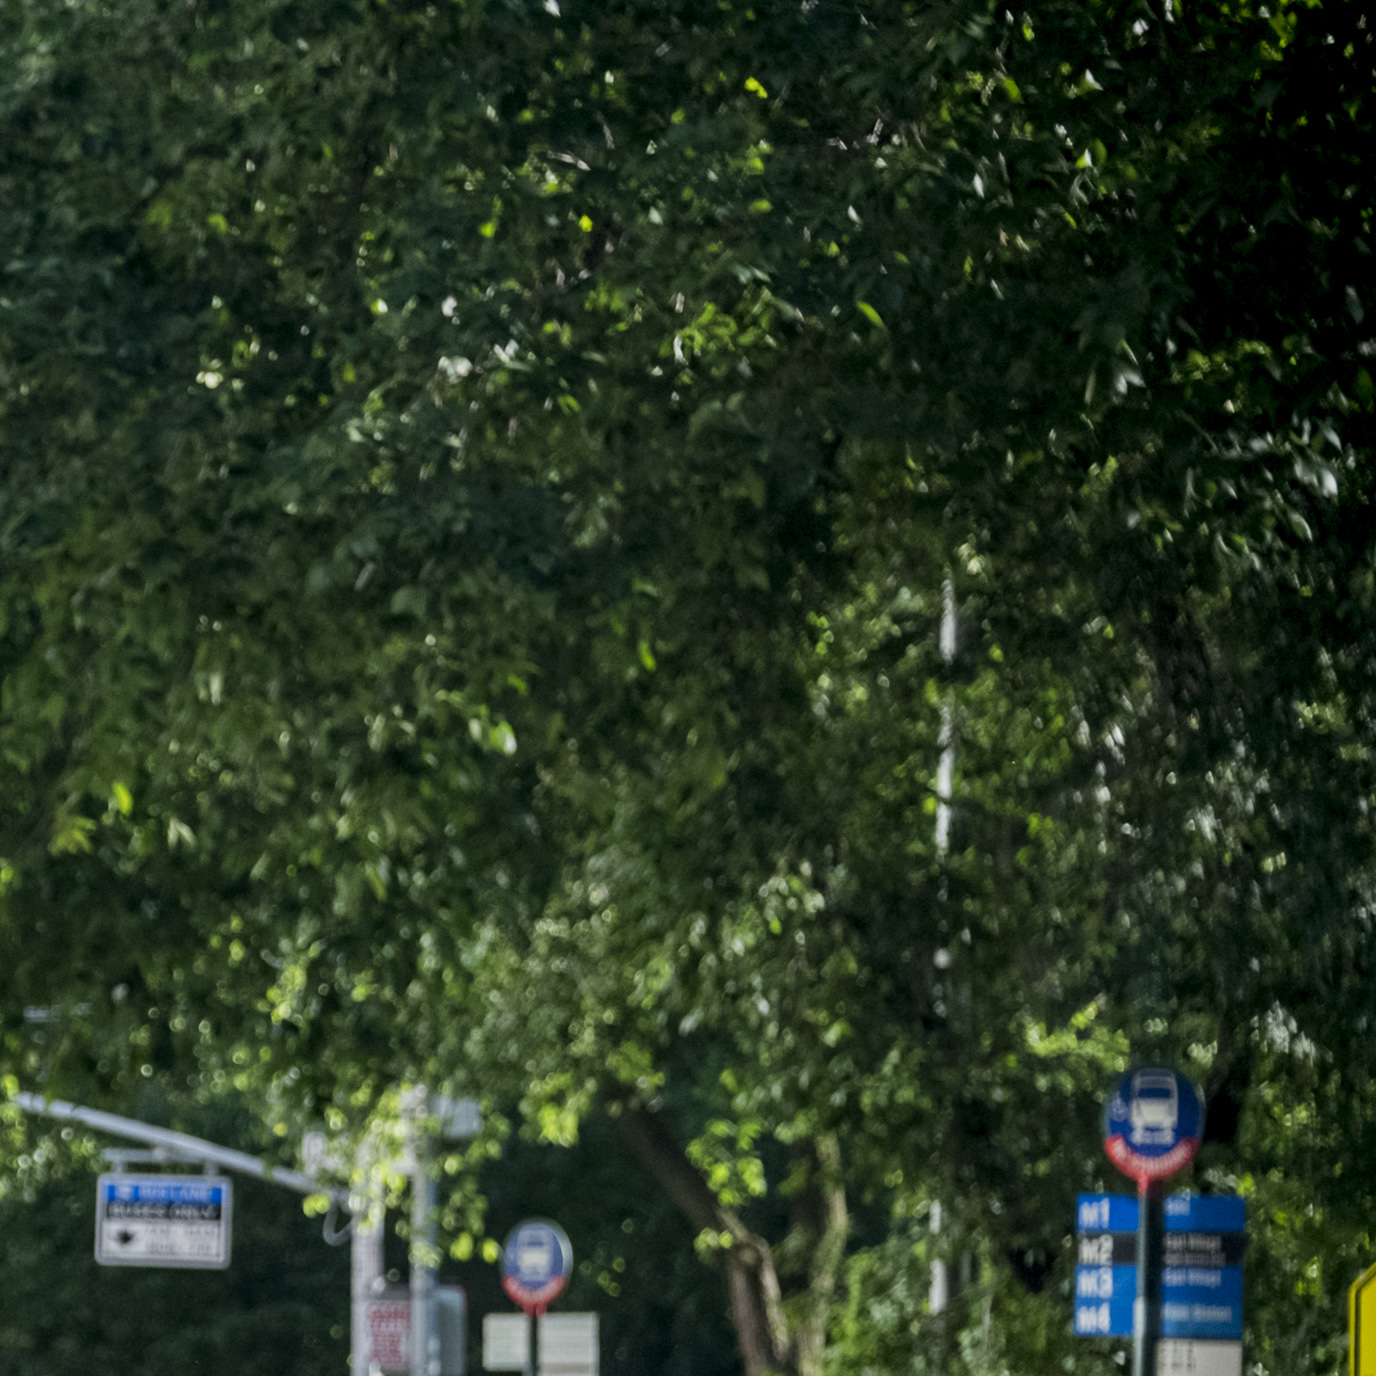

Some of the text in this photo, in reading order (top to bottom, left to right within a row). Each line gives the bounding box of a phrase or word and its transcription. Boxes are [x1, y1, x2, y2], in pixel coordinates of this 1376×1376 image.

[1078, 1197, 1110, 1228] M1
[1078, 1234, 1114, 1267] M2
[1078, 1267, 1114, 1299] M3
